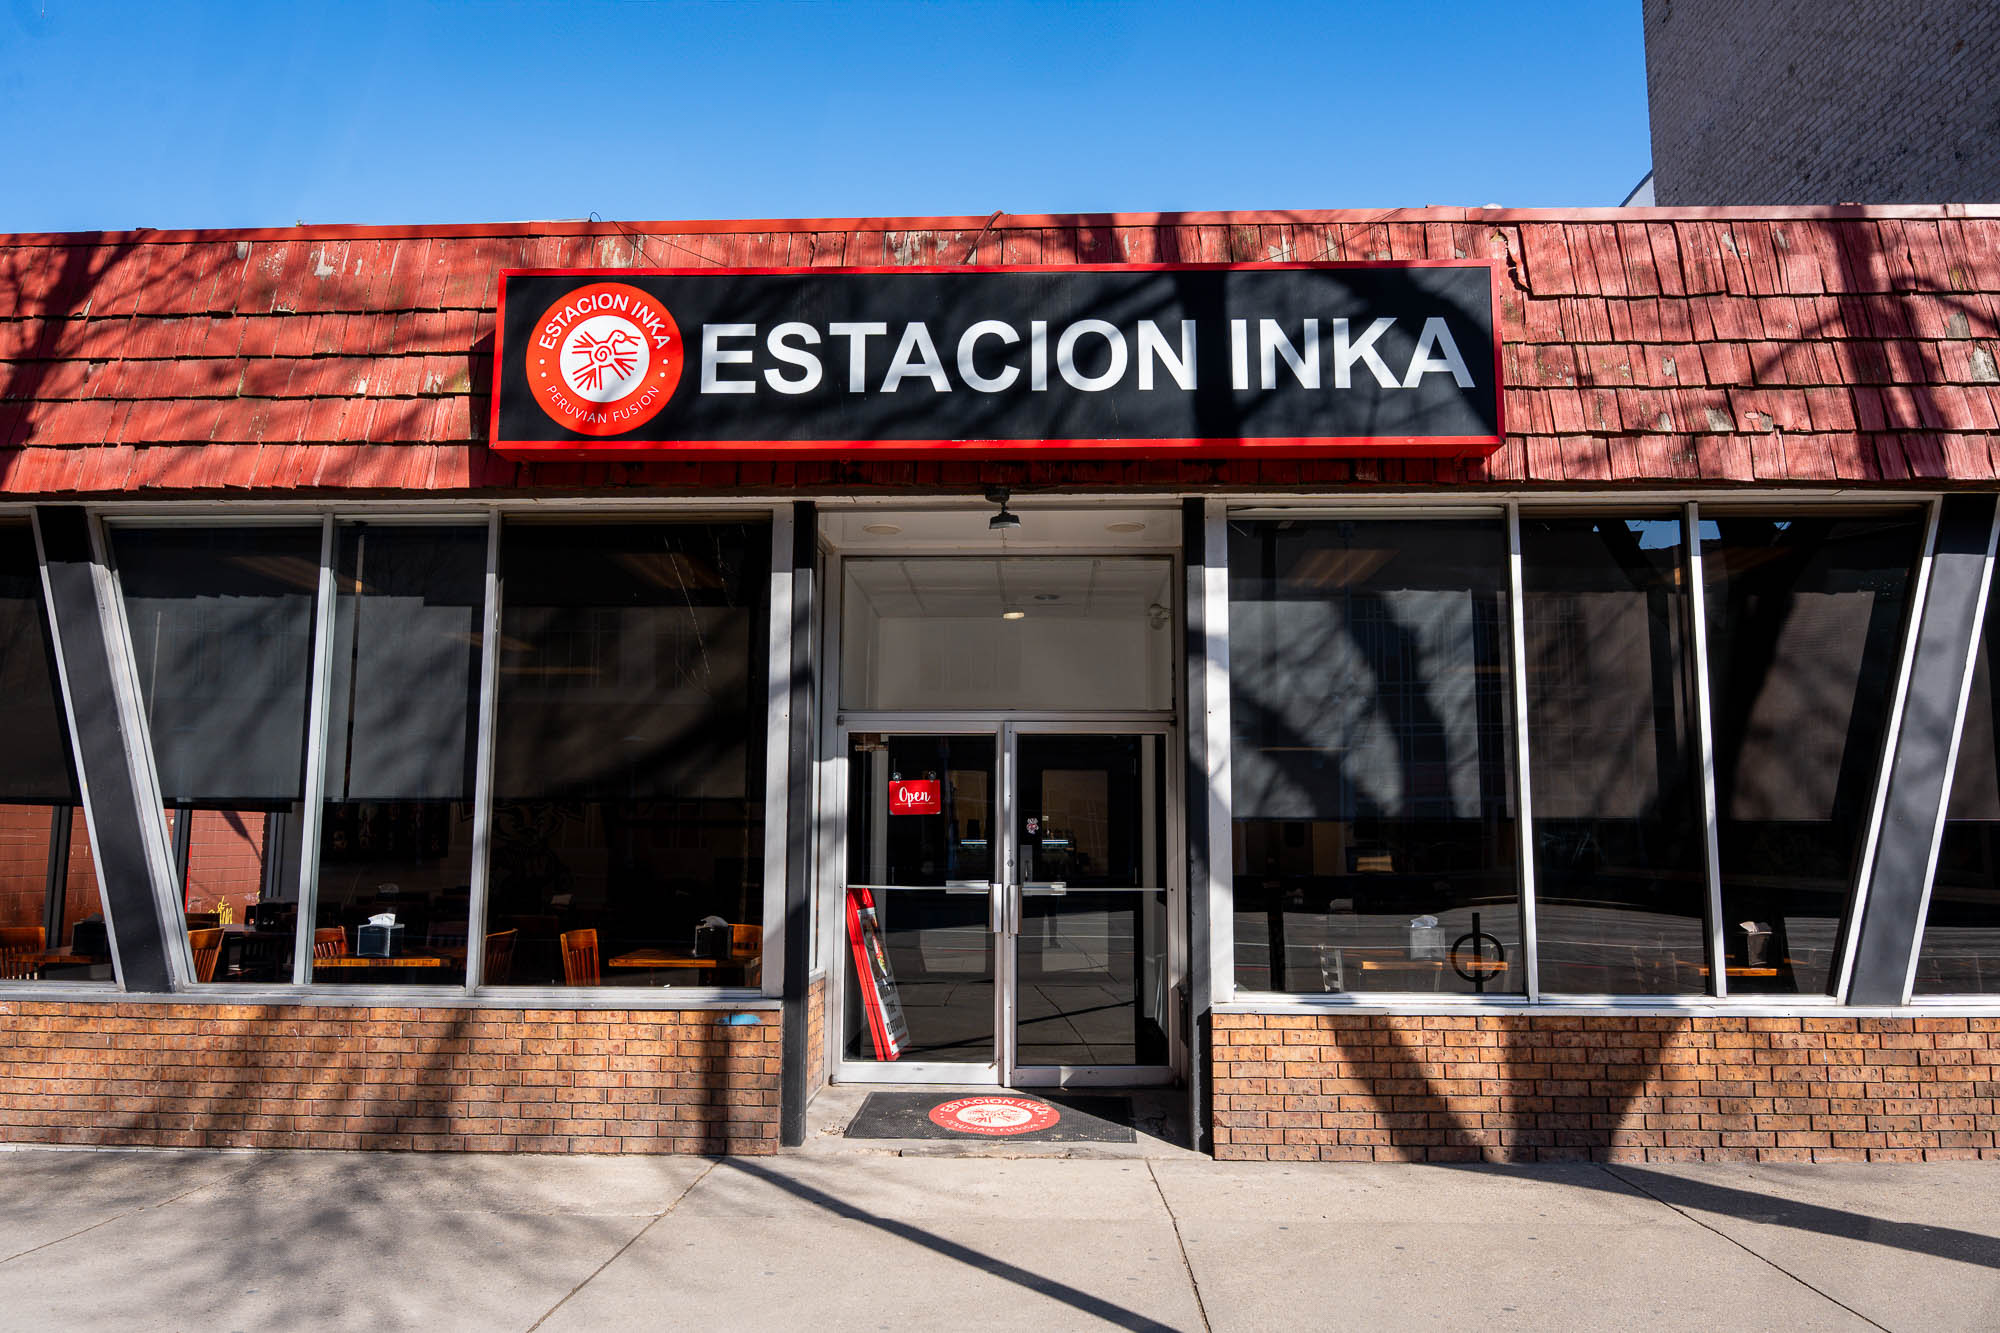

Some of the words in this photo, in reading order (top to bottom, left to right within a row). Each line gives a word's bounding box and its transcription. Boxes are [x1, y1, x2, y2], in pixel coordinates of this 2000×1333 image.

[538, 293, 629, 350] ESTACION
[631, 301, 671, 350] INKA
[700, 318, 1198, 395] ESTACION
[1230, 316, 1476, 391] INKA
[546, 385, 607, 424] PERUVIAN
[612, 385, 660, 423] FUSION
[899, 786, 931, 808] Open
[940, 1098, 1015, 1113] ESTACION
